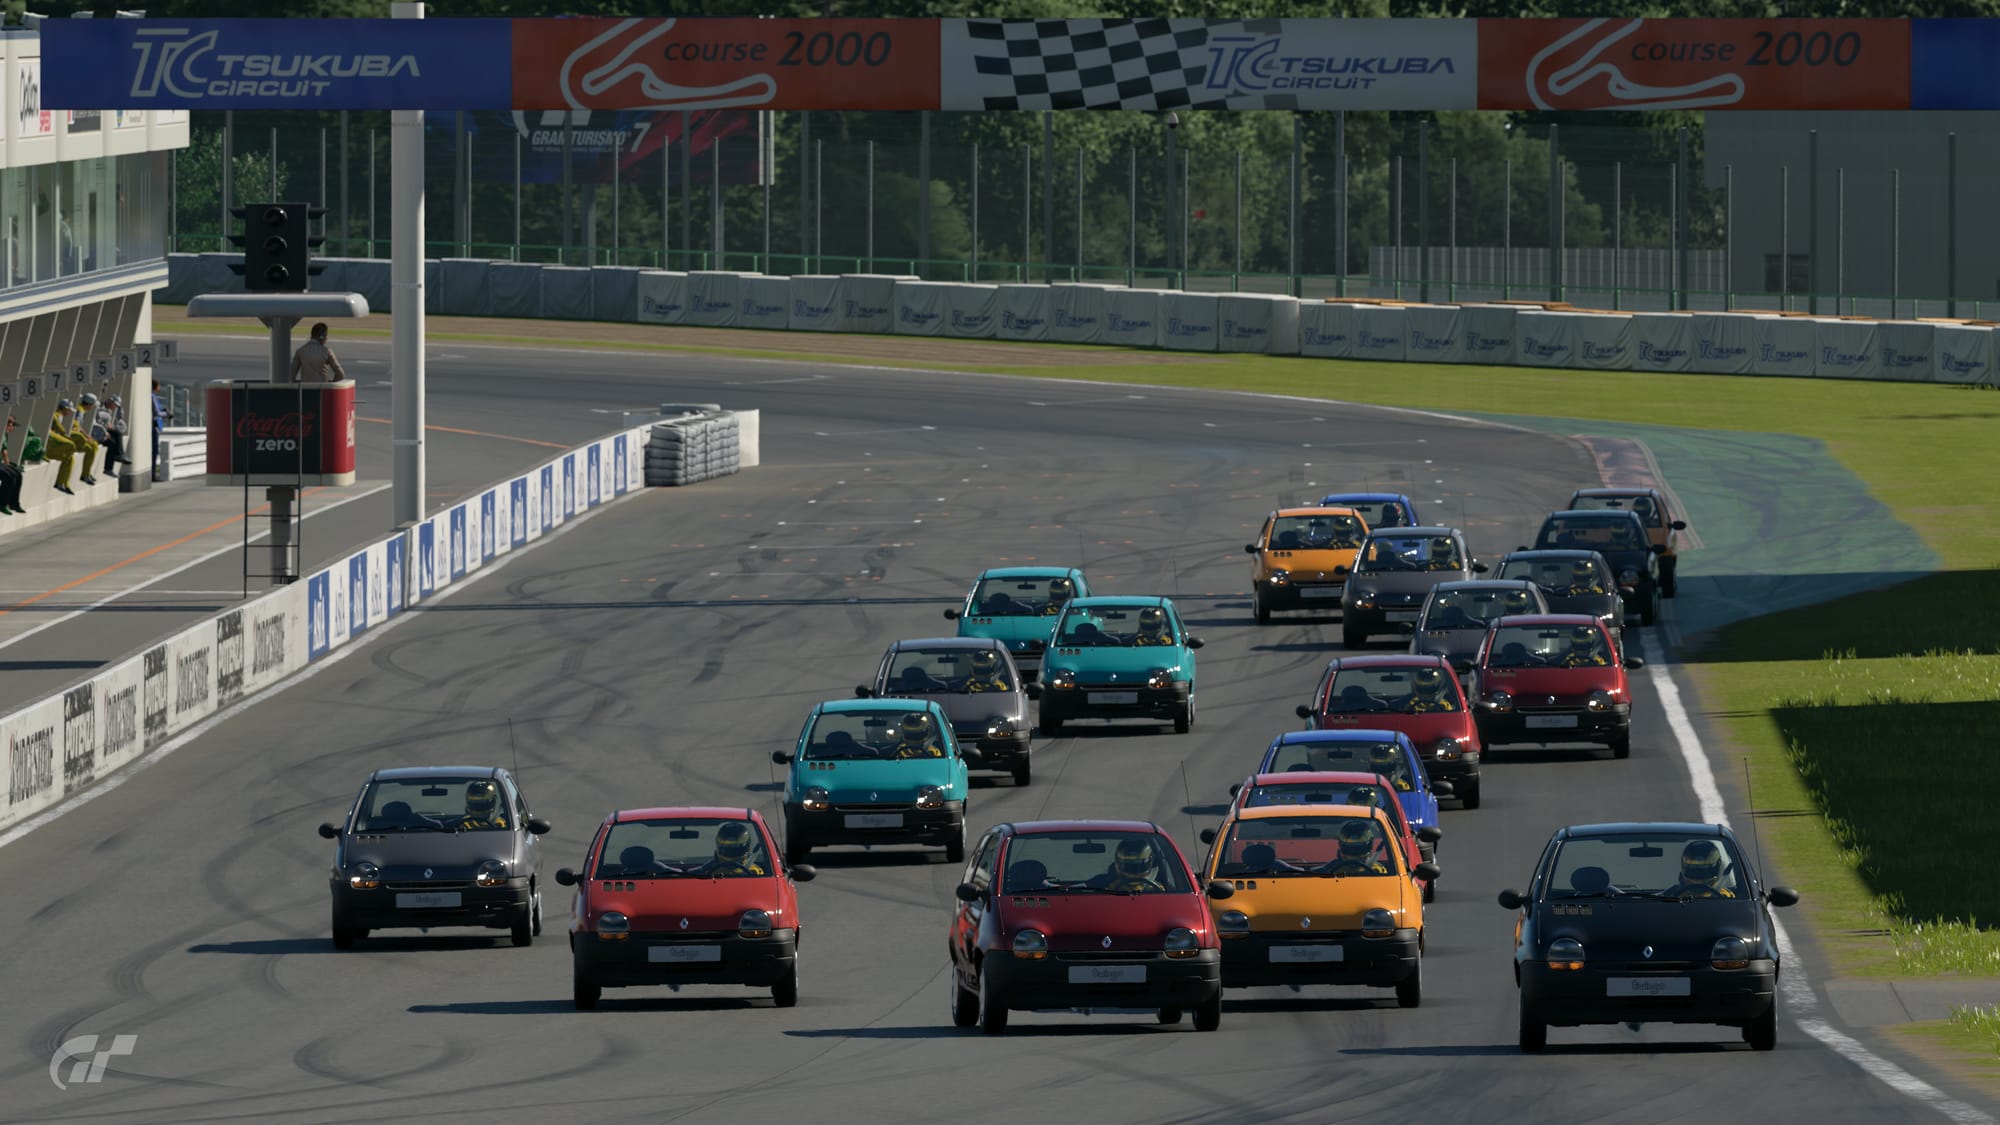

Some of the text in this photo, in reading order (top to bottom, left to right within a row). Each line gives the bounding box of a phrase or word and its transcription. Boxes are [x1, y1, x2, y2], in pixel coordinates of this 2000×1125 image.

[664, 31, 892, 67] course 2000
[1631, 31, 1861, 67] course 2000
[216, 55, 421, 77] TSUKUBA
[1280, 57, 1456, 74] TSUKUBA
[532, 122, 652, 153] GRAN TURISMO 7
[143, 350, 151, 363] 2
[164, 343, 170, 358] 1
[99, 361, 107, 375] 5
[121, 355, 129, 369] 3
[53, 374, 61, 388] 7
[76, 367, 85, 381] 6
[2, 386, 11, 398] 9
[27, 380, 37, 394] 8
[256, 439, 297, 451] zero
